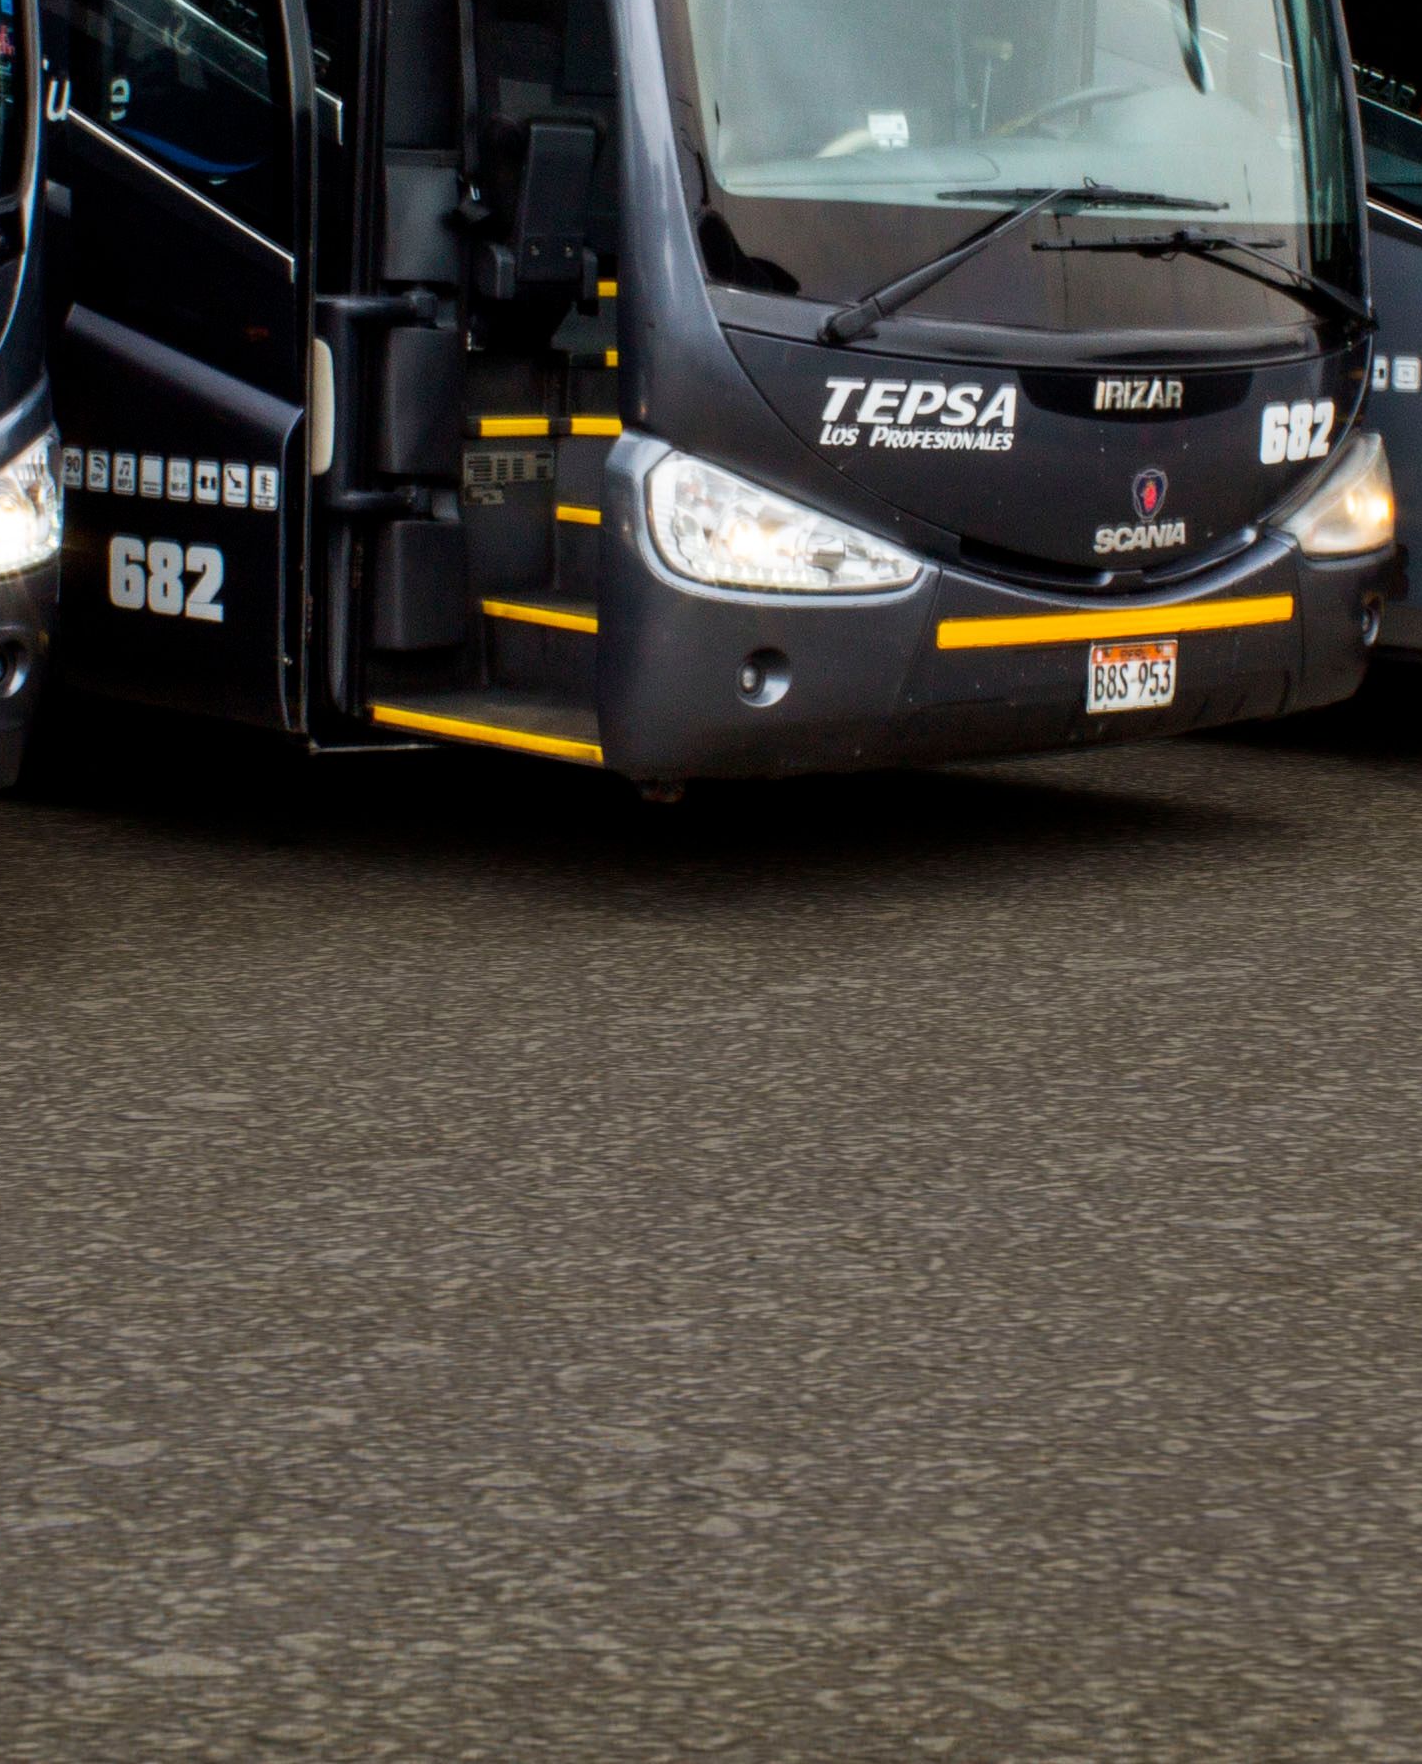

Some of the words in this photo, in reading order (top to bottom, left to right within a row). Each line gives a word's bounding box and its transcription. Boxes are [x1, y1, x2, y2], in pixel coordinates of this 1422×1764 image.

[821, 376, 1017, 427] TEPSA
[1093, 375, 1185, 411] IRIZAR
[1259, 397, 1335, 465] 682
[1092, 516, 1187, 555] SCANIA
[108, 533, 224, 623] 682
[1093, 659, 1172, 703] B8S-953
